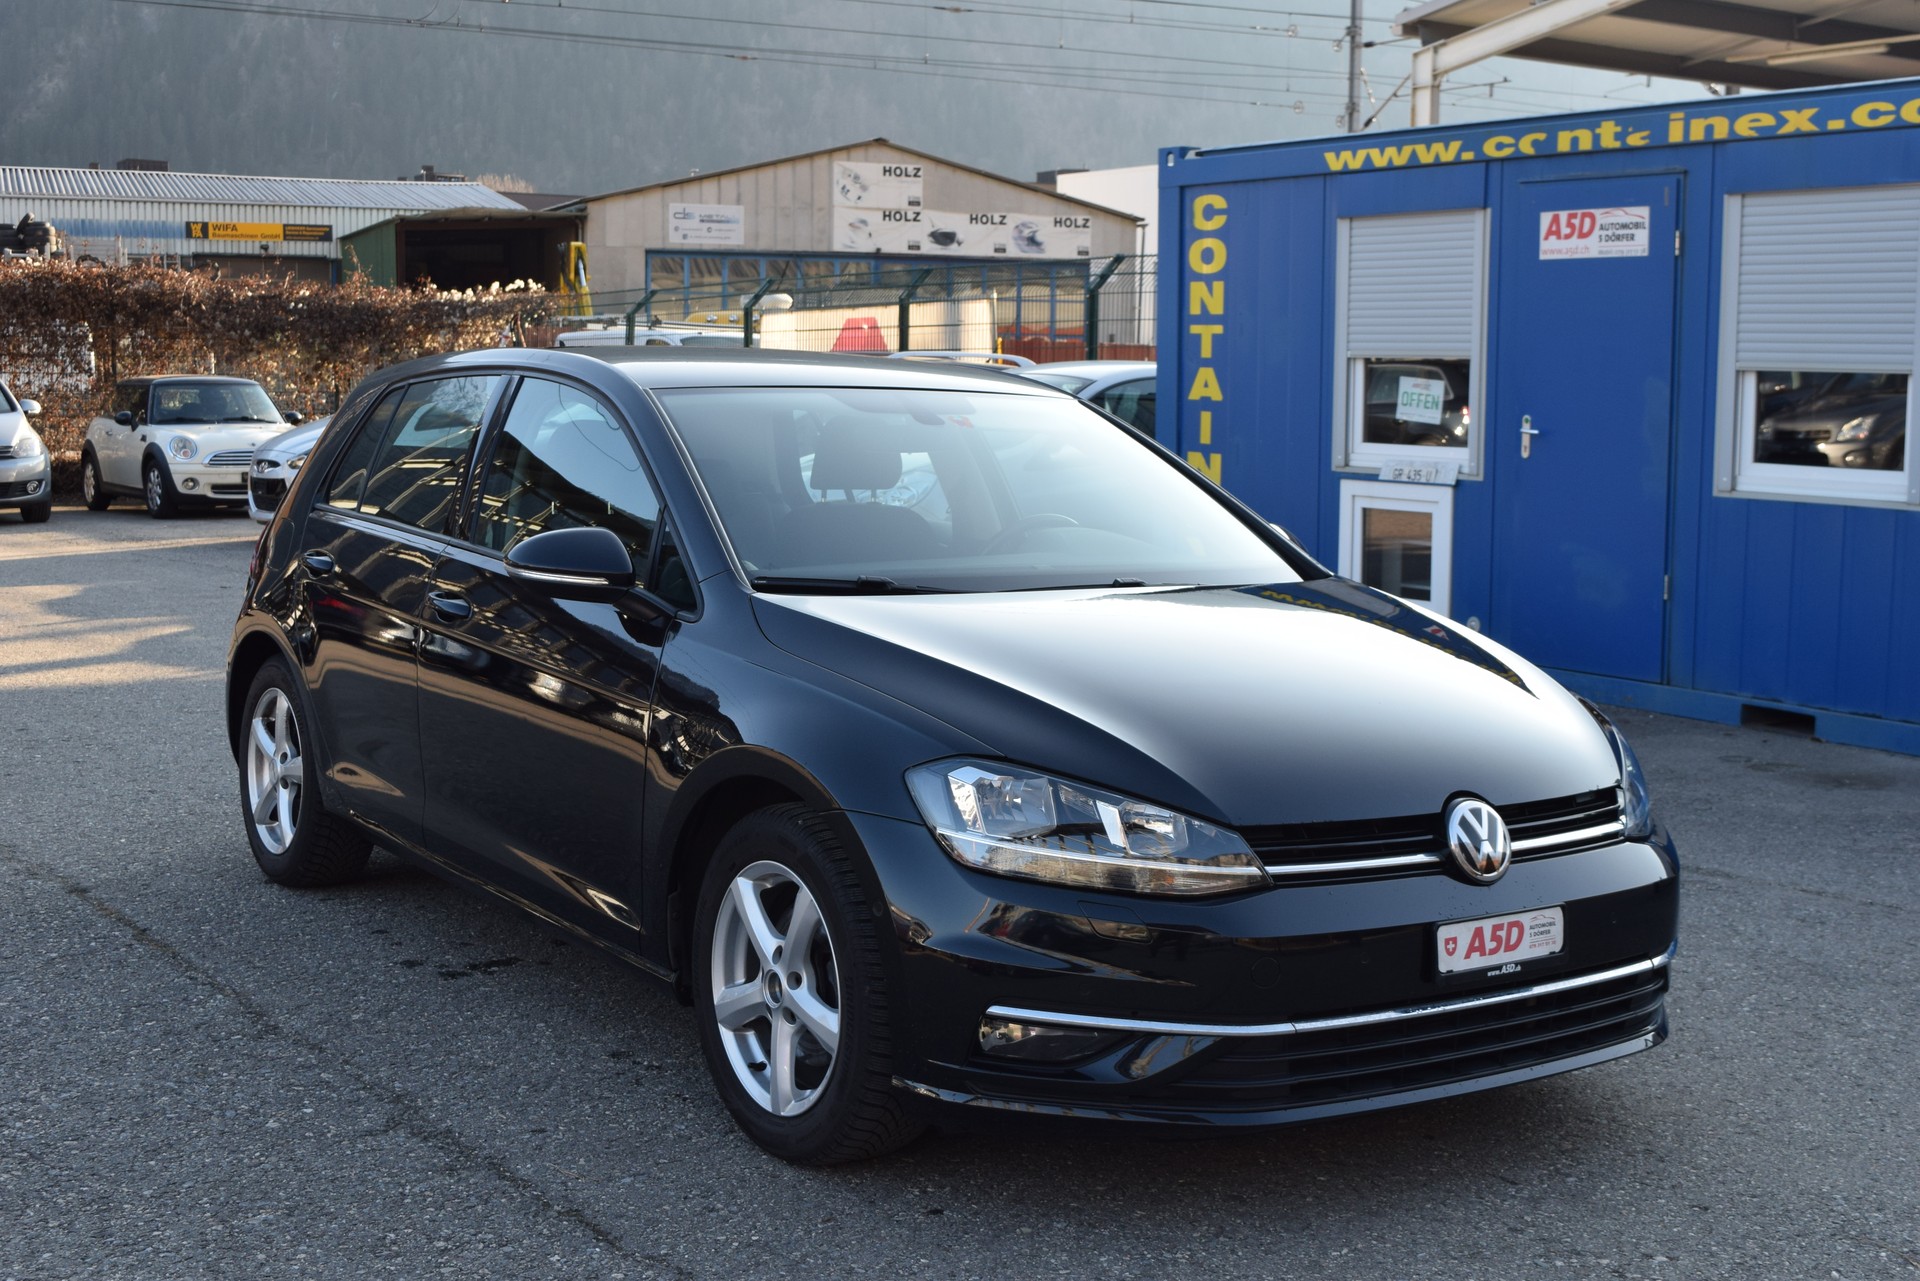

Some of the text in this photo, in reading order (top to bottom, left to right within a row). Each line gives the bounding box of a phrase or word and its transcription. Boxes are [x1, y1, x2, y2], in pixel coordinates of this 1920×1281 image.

[883, 166, 921, 178] HOLZ
[883, 211, 921, 222] HOLZ
[969, 214, 1007, 225] HOLZ
[212, 223, 238, 232] WIFA
[1054, 217, 1090, 228] HOLZ
[1543, 211, 1596, 240] A5D
[1599, 222, 1646, 231] AUTOMOBIL
[260, 232, 281, 240] GmbH
[1604, 232, 1635, 242] DÖRFER
[1401, 391, 1440, 410] OFFEN
[1529, 921, 1556, 929] AUTOMOBIL
[1533, 929, 1551, 937] DÖRFER
[1463, 920, 1525, 960] A5D
